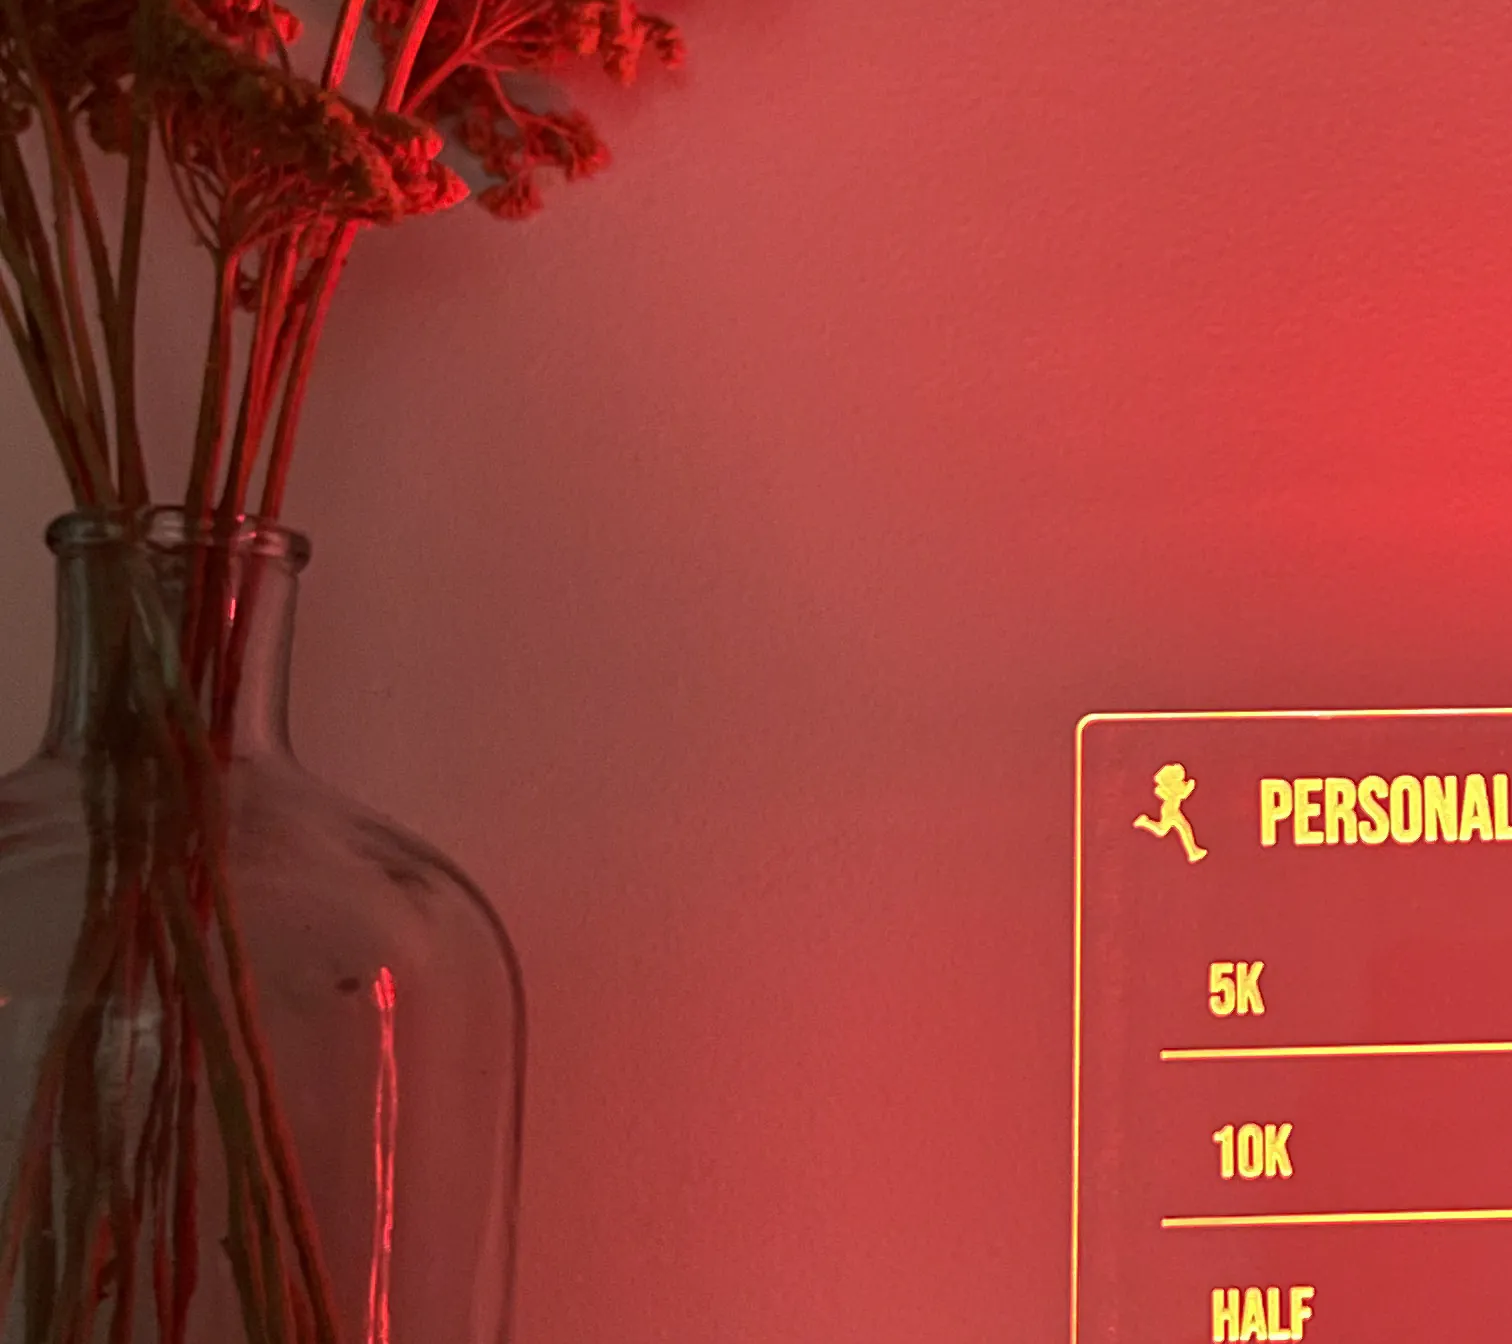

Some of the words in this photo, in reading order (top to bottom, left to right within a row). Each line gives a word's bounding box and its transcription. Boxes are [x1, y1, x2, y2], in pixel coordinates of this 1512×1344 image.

[1209, 961, 1266, 1016] 5K
[1212, 1122, 1294, 1179] 10K
[1211, 1286, 1315, 1344] HALF
